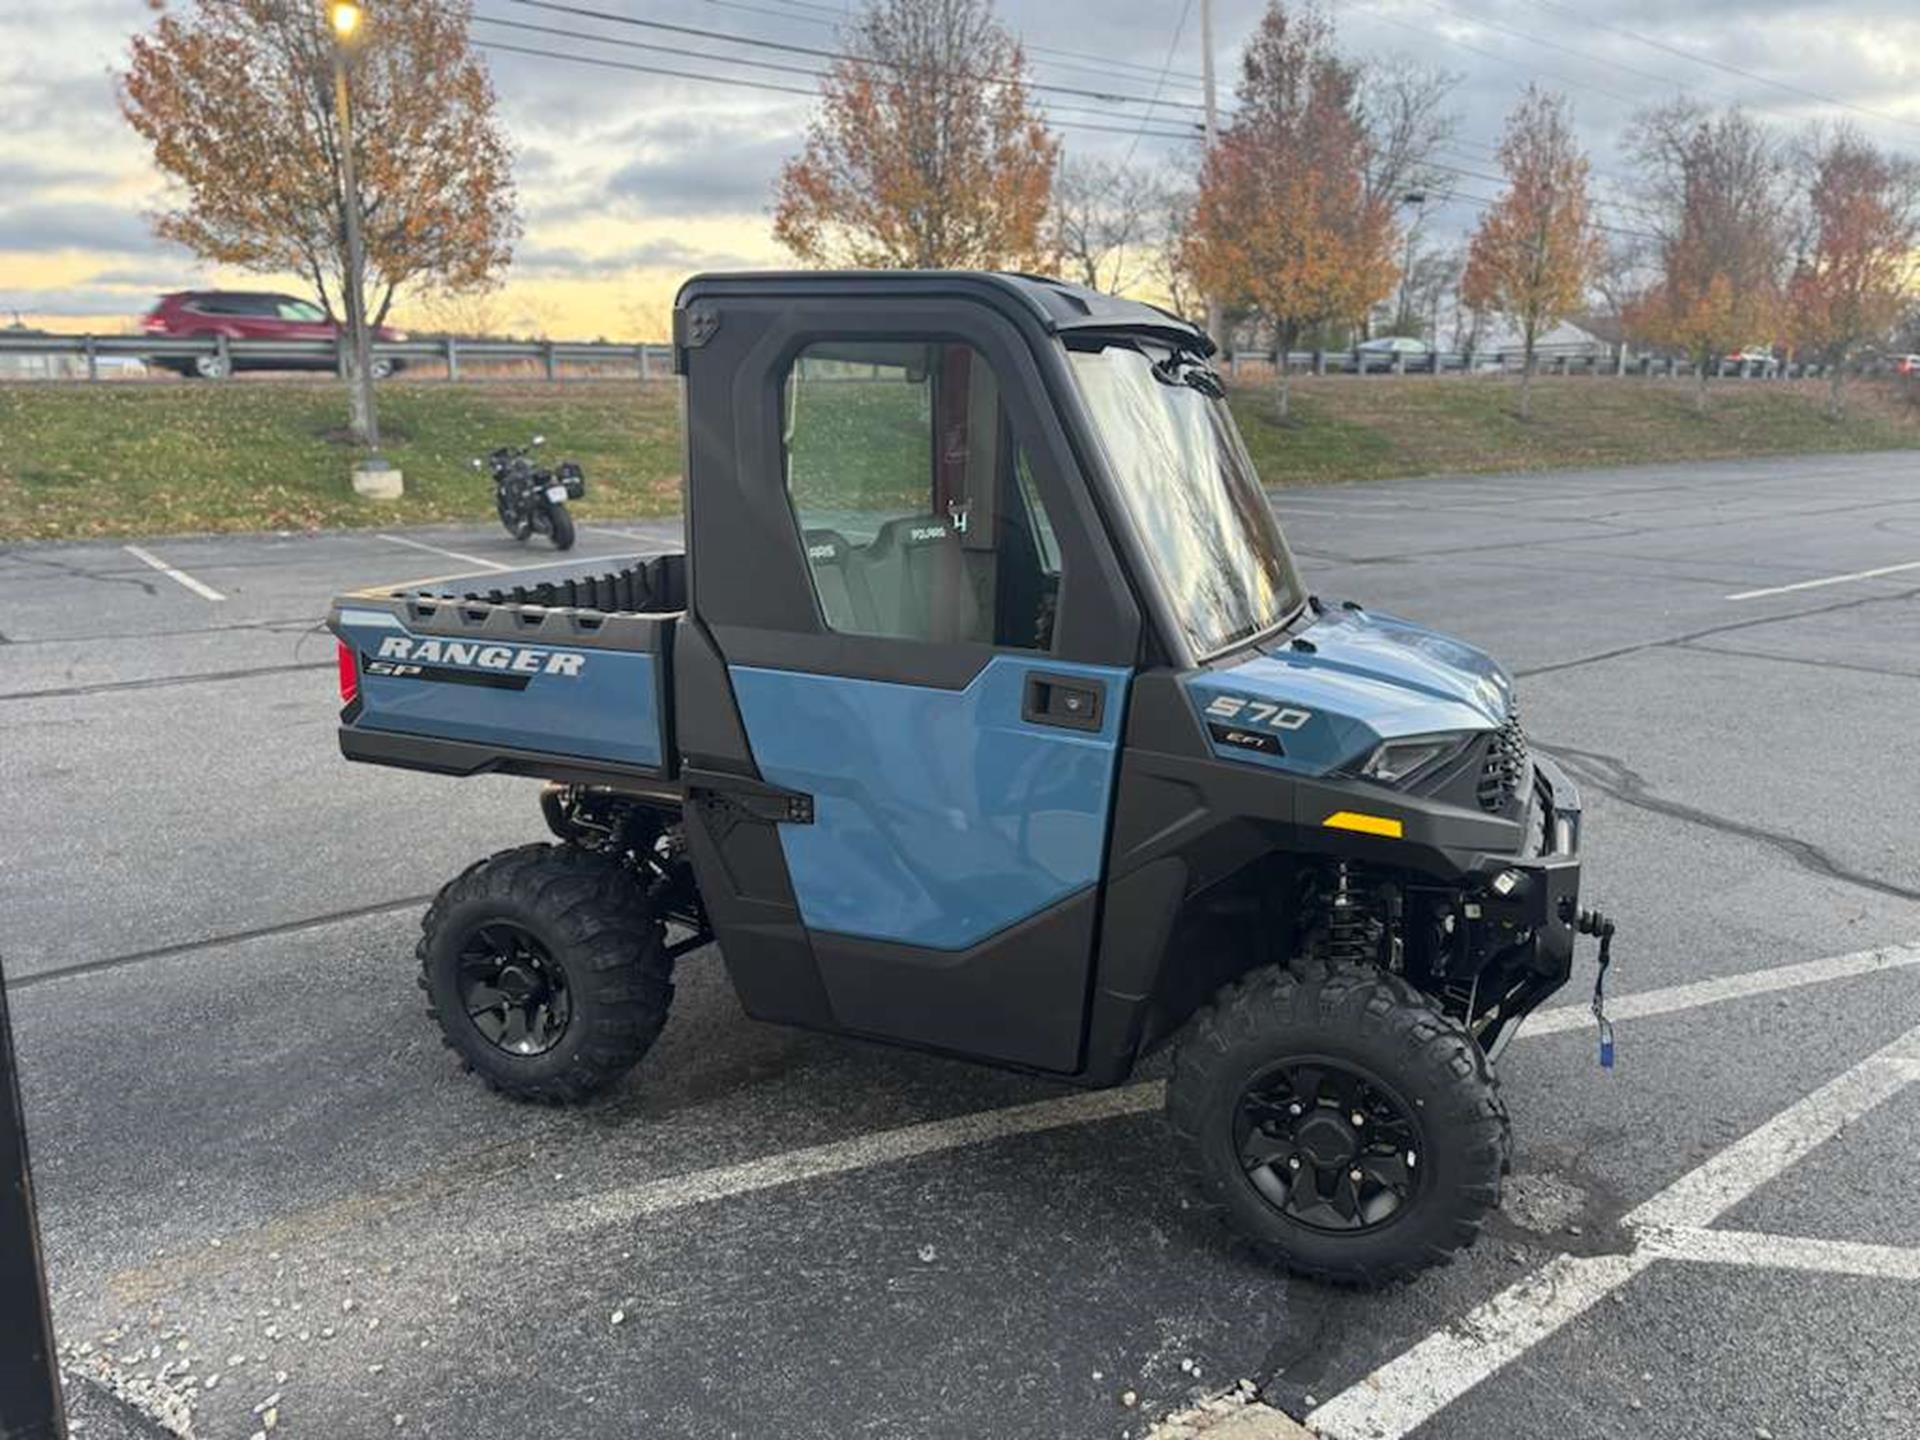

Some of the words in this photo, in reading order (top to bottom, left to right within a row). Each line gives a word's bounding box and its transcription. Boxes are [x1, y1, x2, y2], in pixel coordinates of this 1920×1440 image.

[365, 662, 423, 676] SP
[378, 637, 586, 676] RANGER
[1205, 696, 1312, 730] 570
